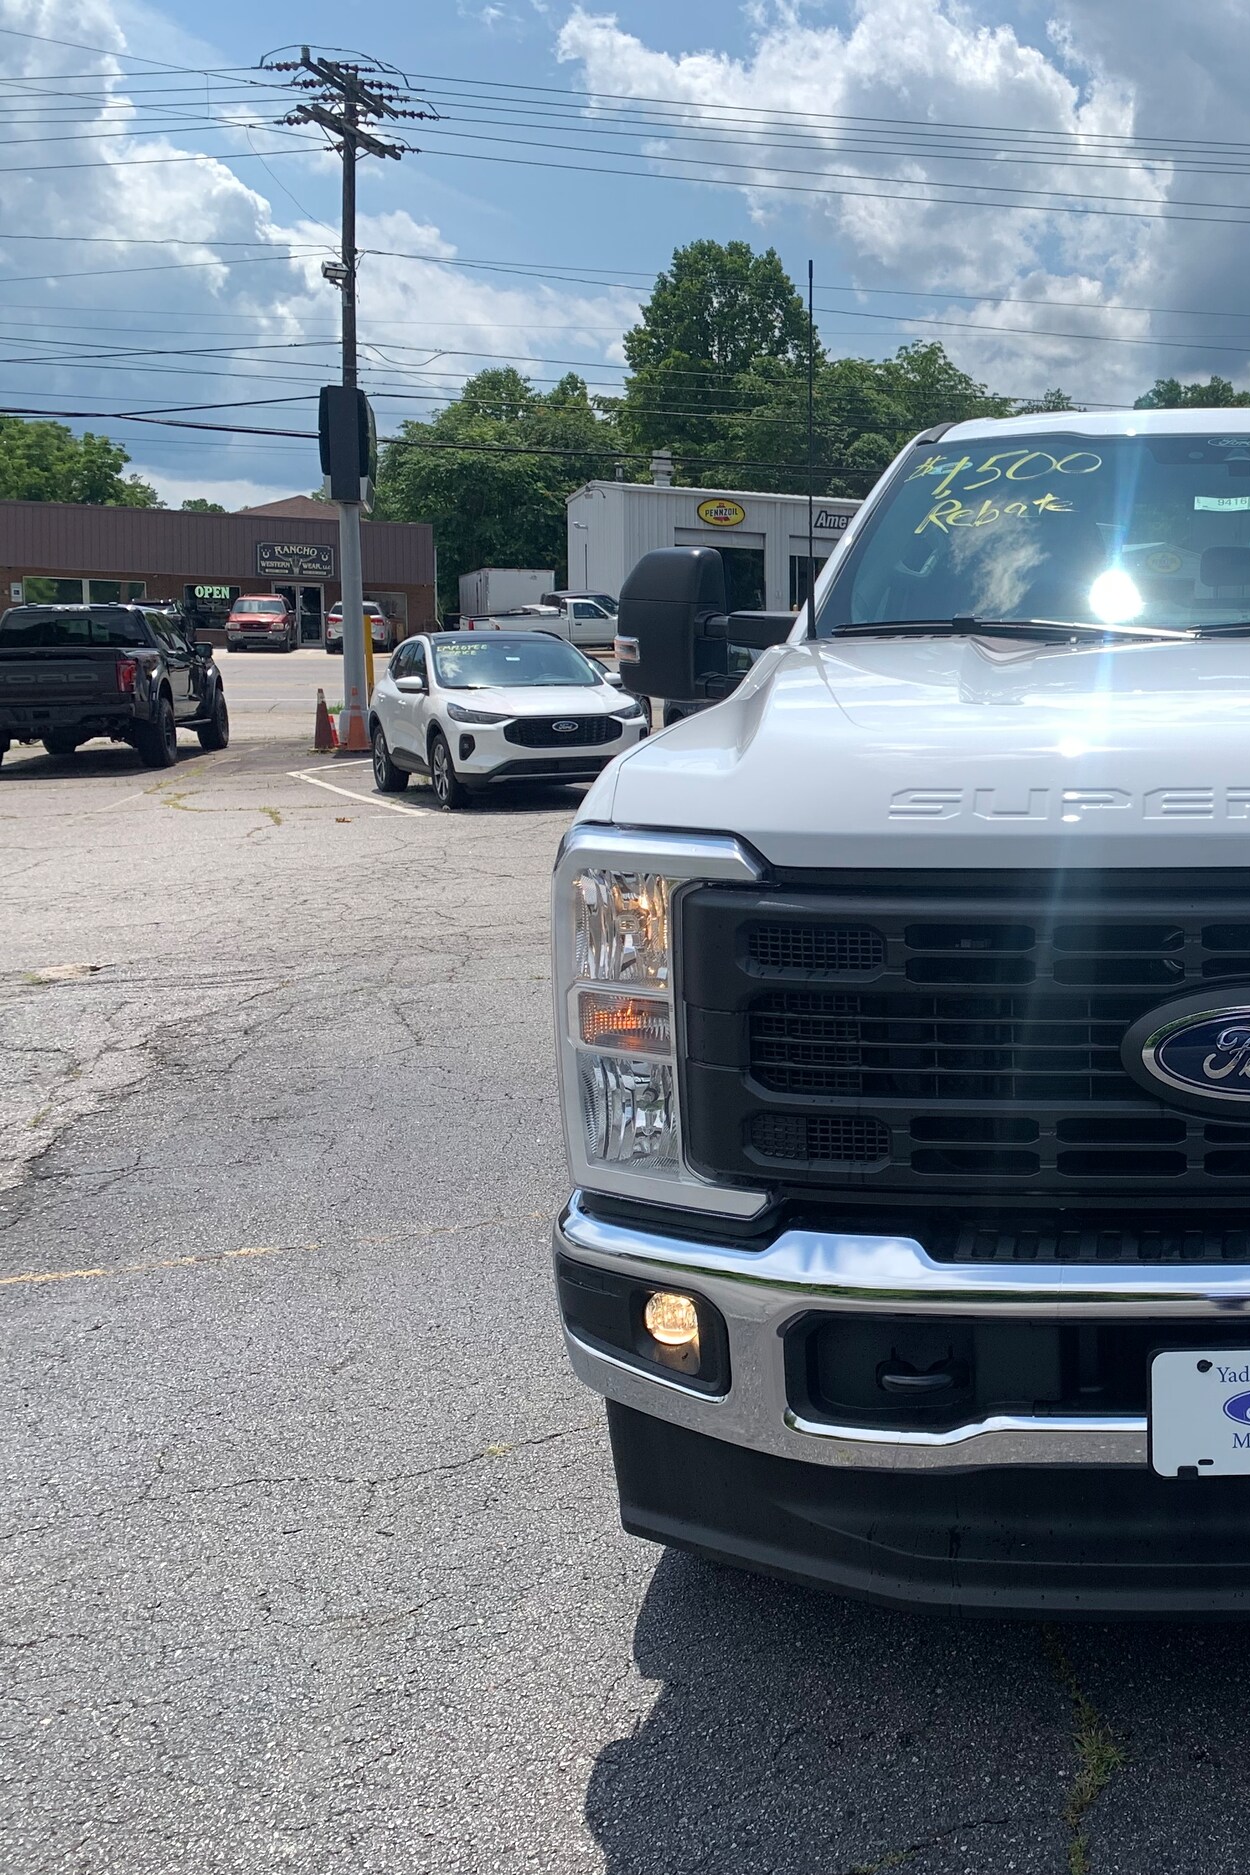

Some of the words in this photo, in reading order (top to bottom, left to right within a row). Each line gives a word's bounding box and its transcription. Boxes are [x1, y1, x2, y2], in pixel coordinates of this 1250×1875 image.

[704, 508, 739, 518] PENNZOIL
[914, 492, 1081, 534] Rebate
[274, 545, 318, 556] RANCHO
[260, 560, 291, 568] WESTERN
[194, 585, 230, 599] OPEN
